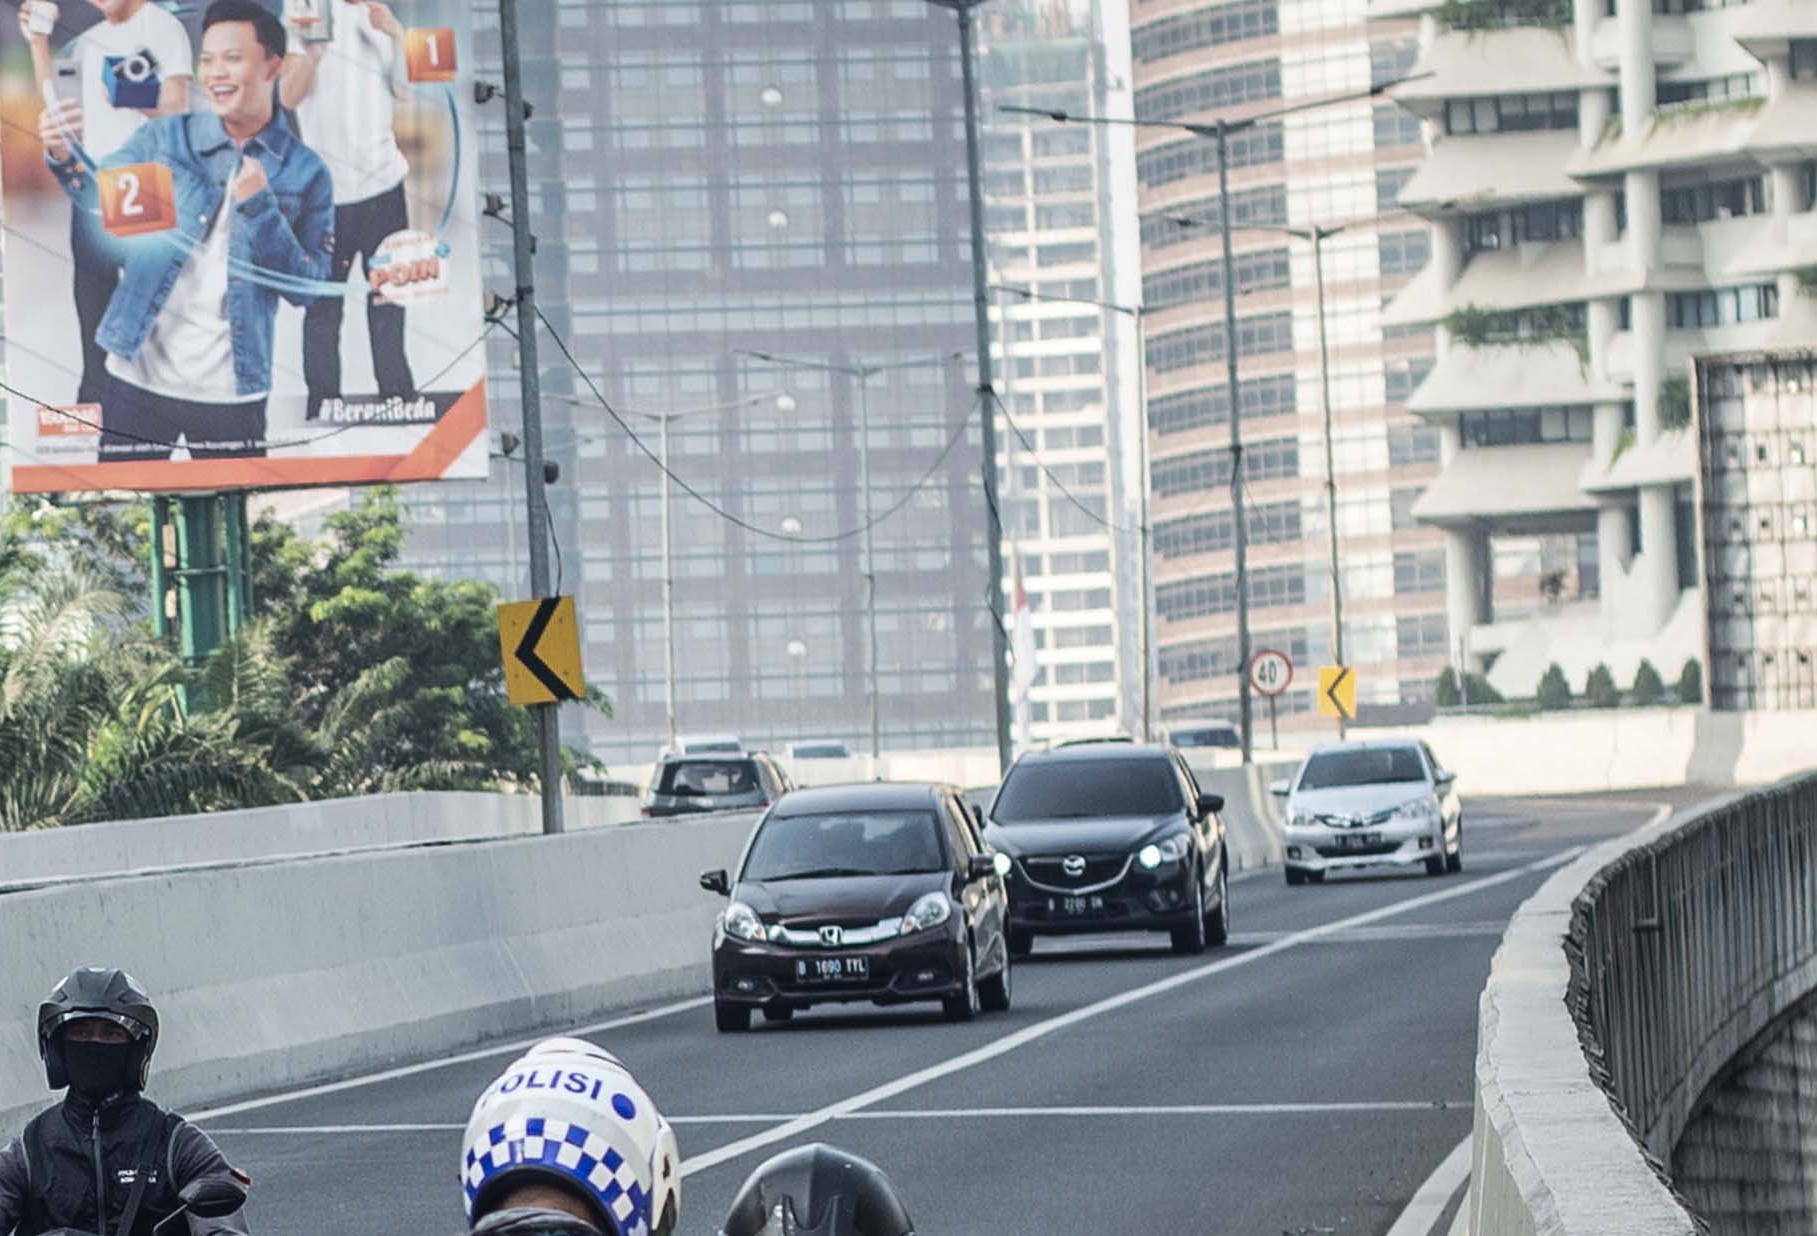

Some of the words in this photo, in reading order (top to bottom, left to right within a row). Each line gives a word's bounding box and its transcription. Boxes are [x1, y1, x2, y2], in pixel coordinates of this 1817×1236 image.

[426, 34, 439, 66] 1
[119, 173, 144, 216] 2
[1257, 660, 1277, 683] 40
